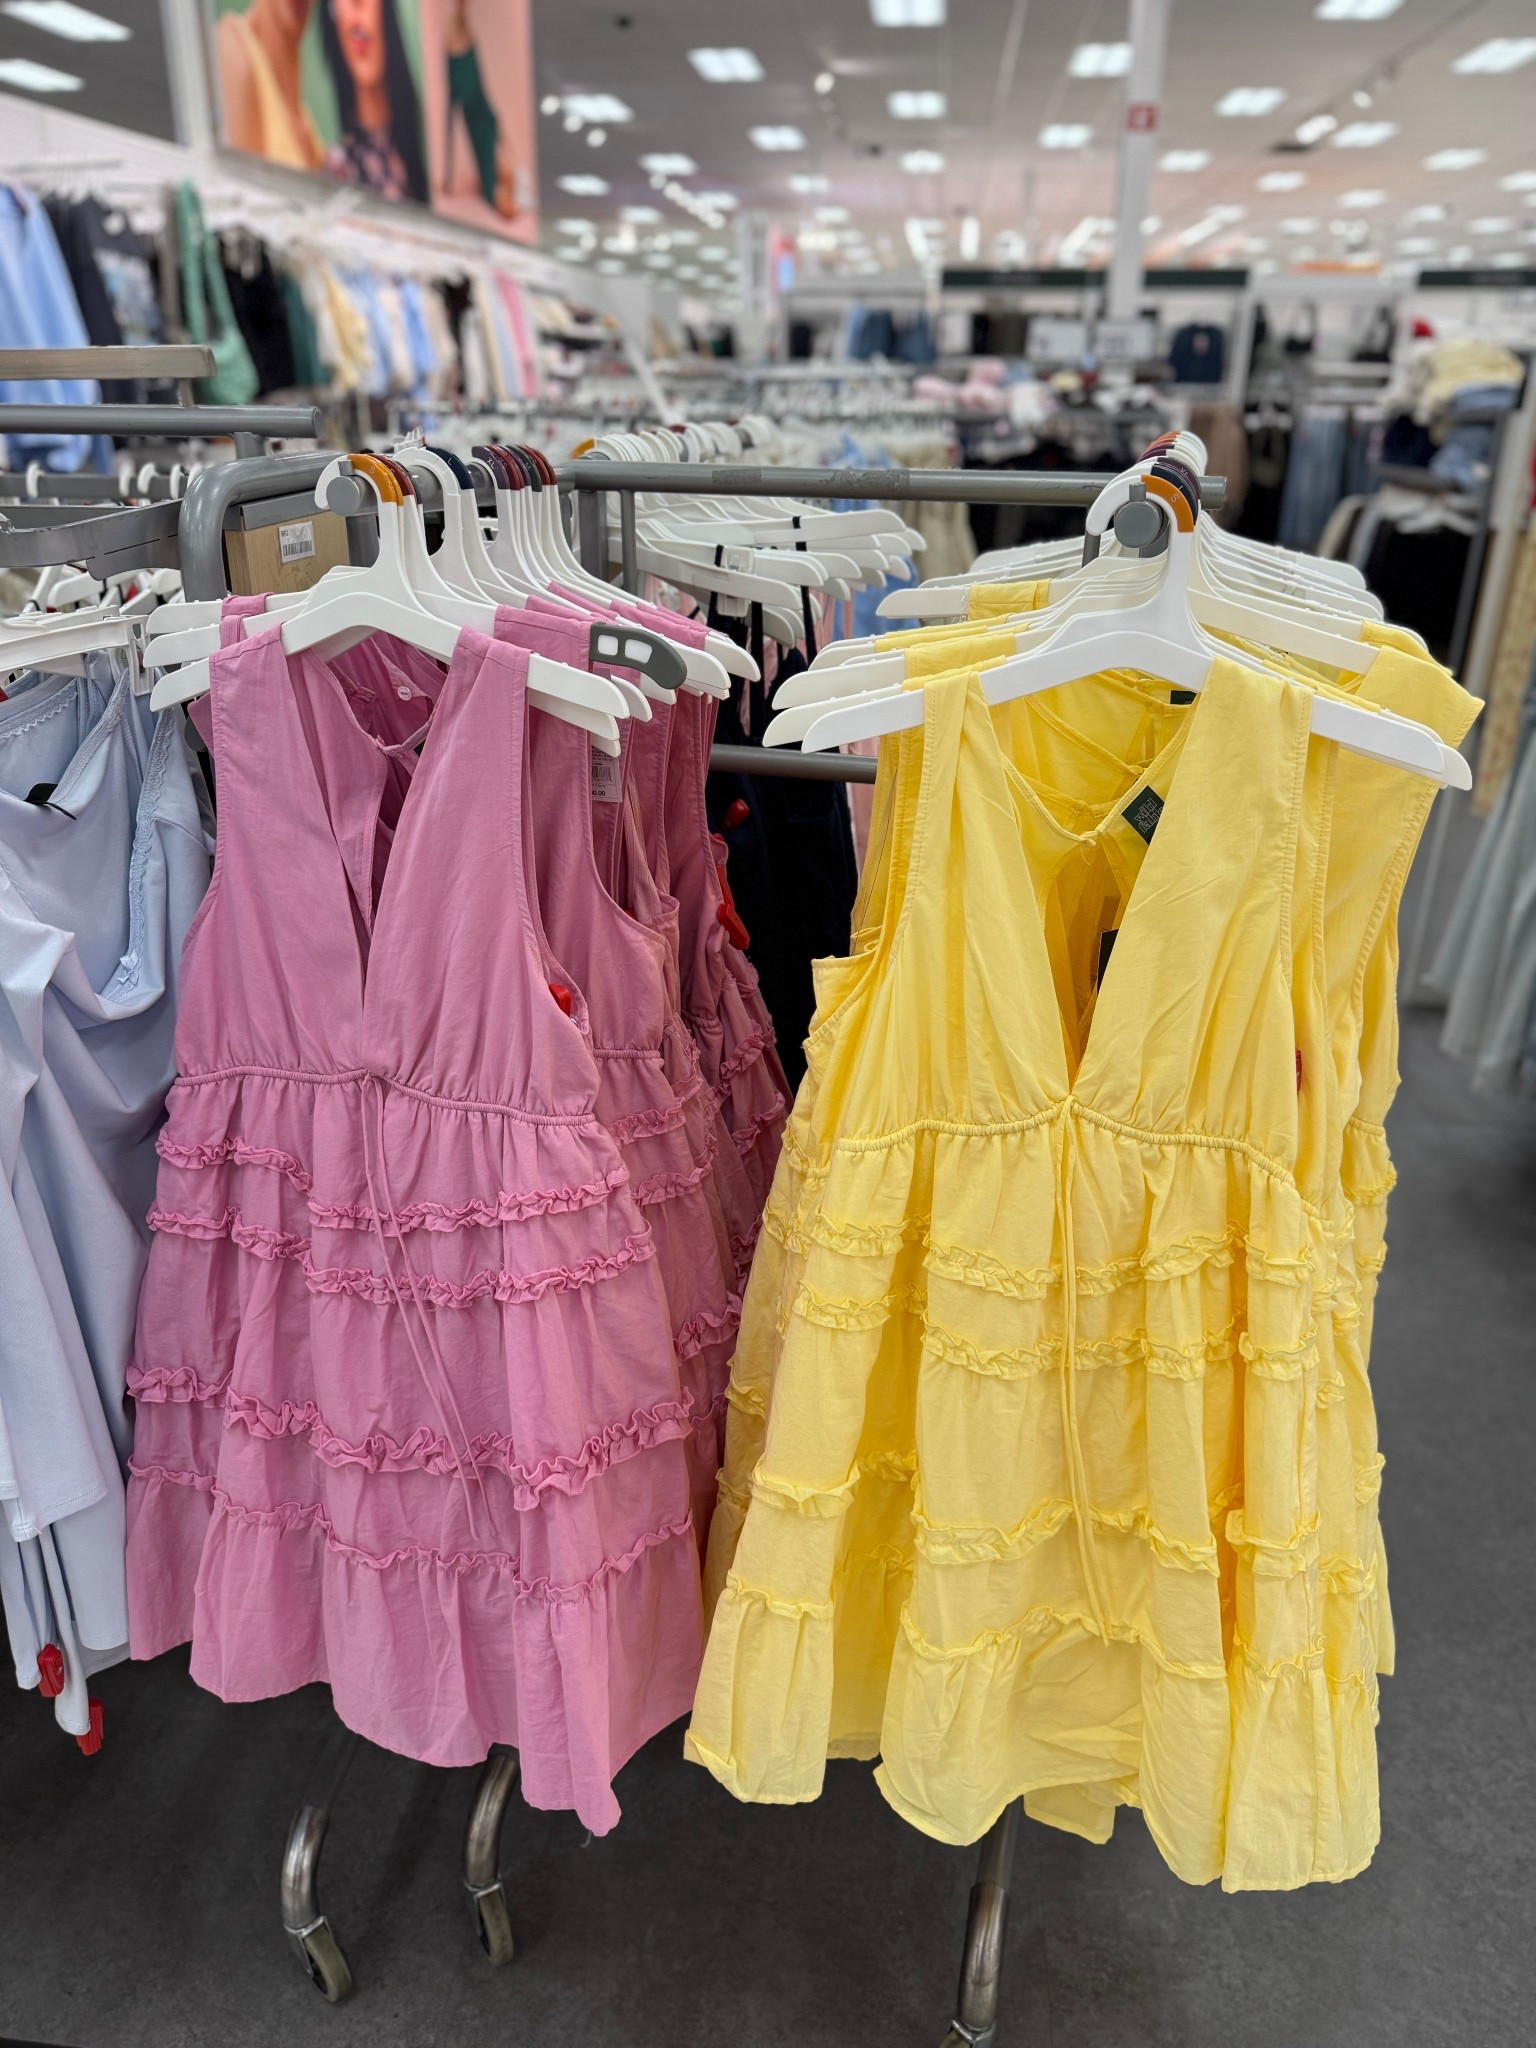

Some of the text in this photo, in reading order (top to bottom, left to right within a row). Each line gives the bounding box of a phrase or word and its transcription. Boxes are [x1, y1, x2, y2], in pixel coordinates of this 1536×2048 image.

[486, 456, 495, 469] XL
[369, 466, 376, 475] S
[1170, 493, 1179, 502] S
[1134, 798, 1157, 821] wild
